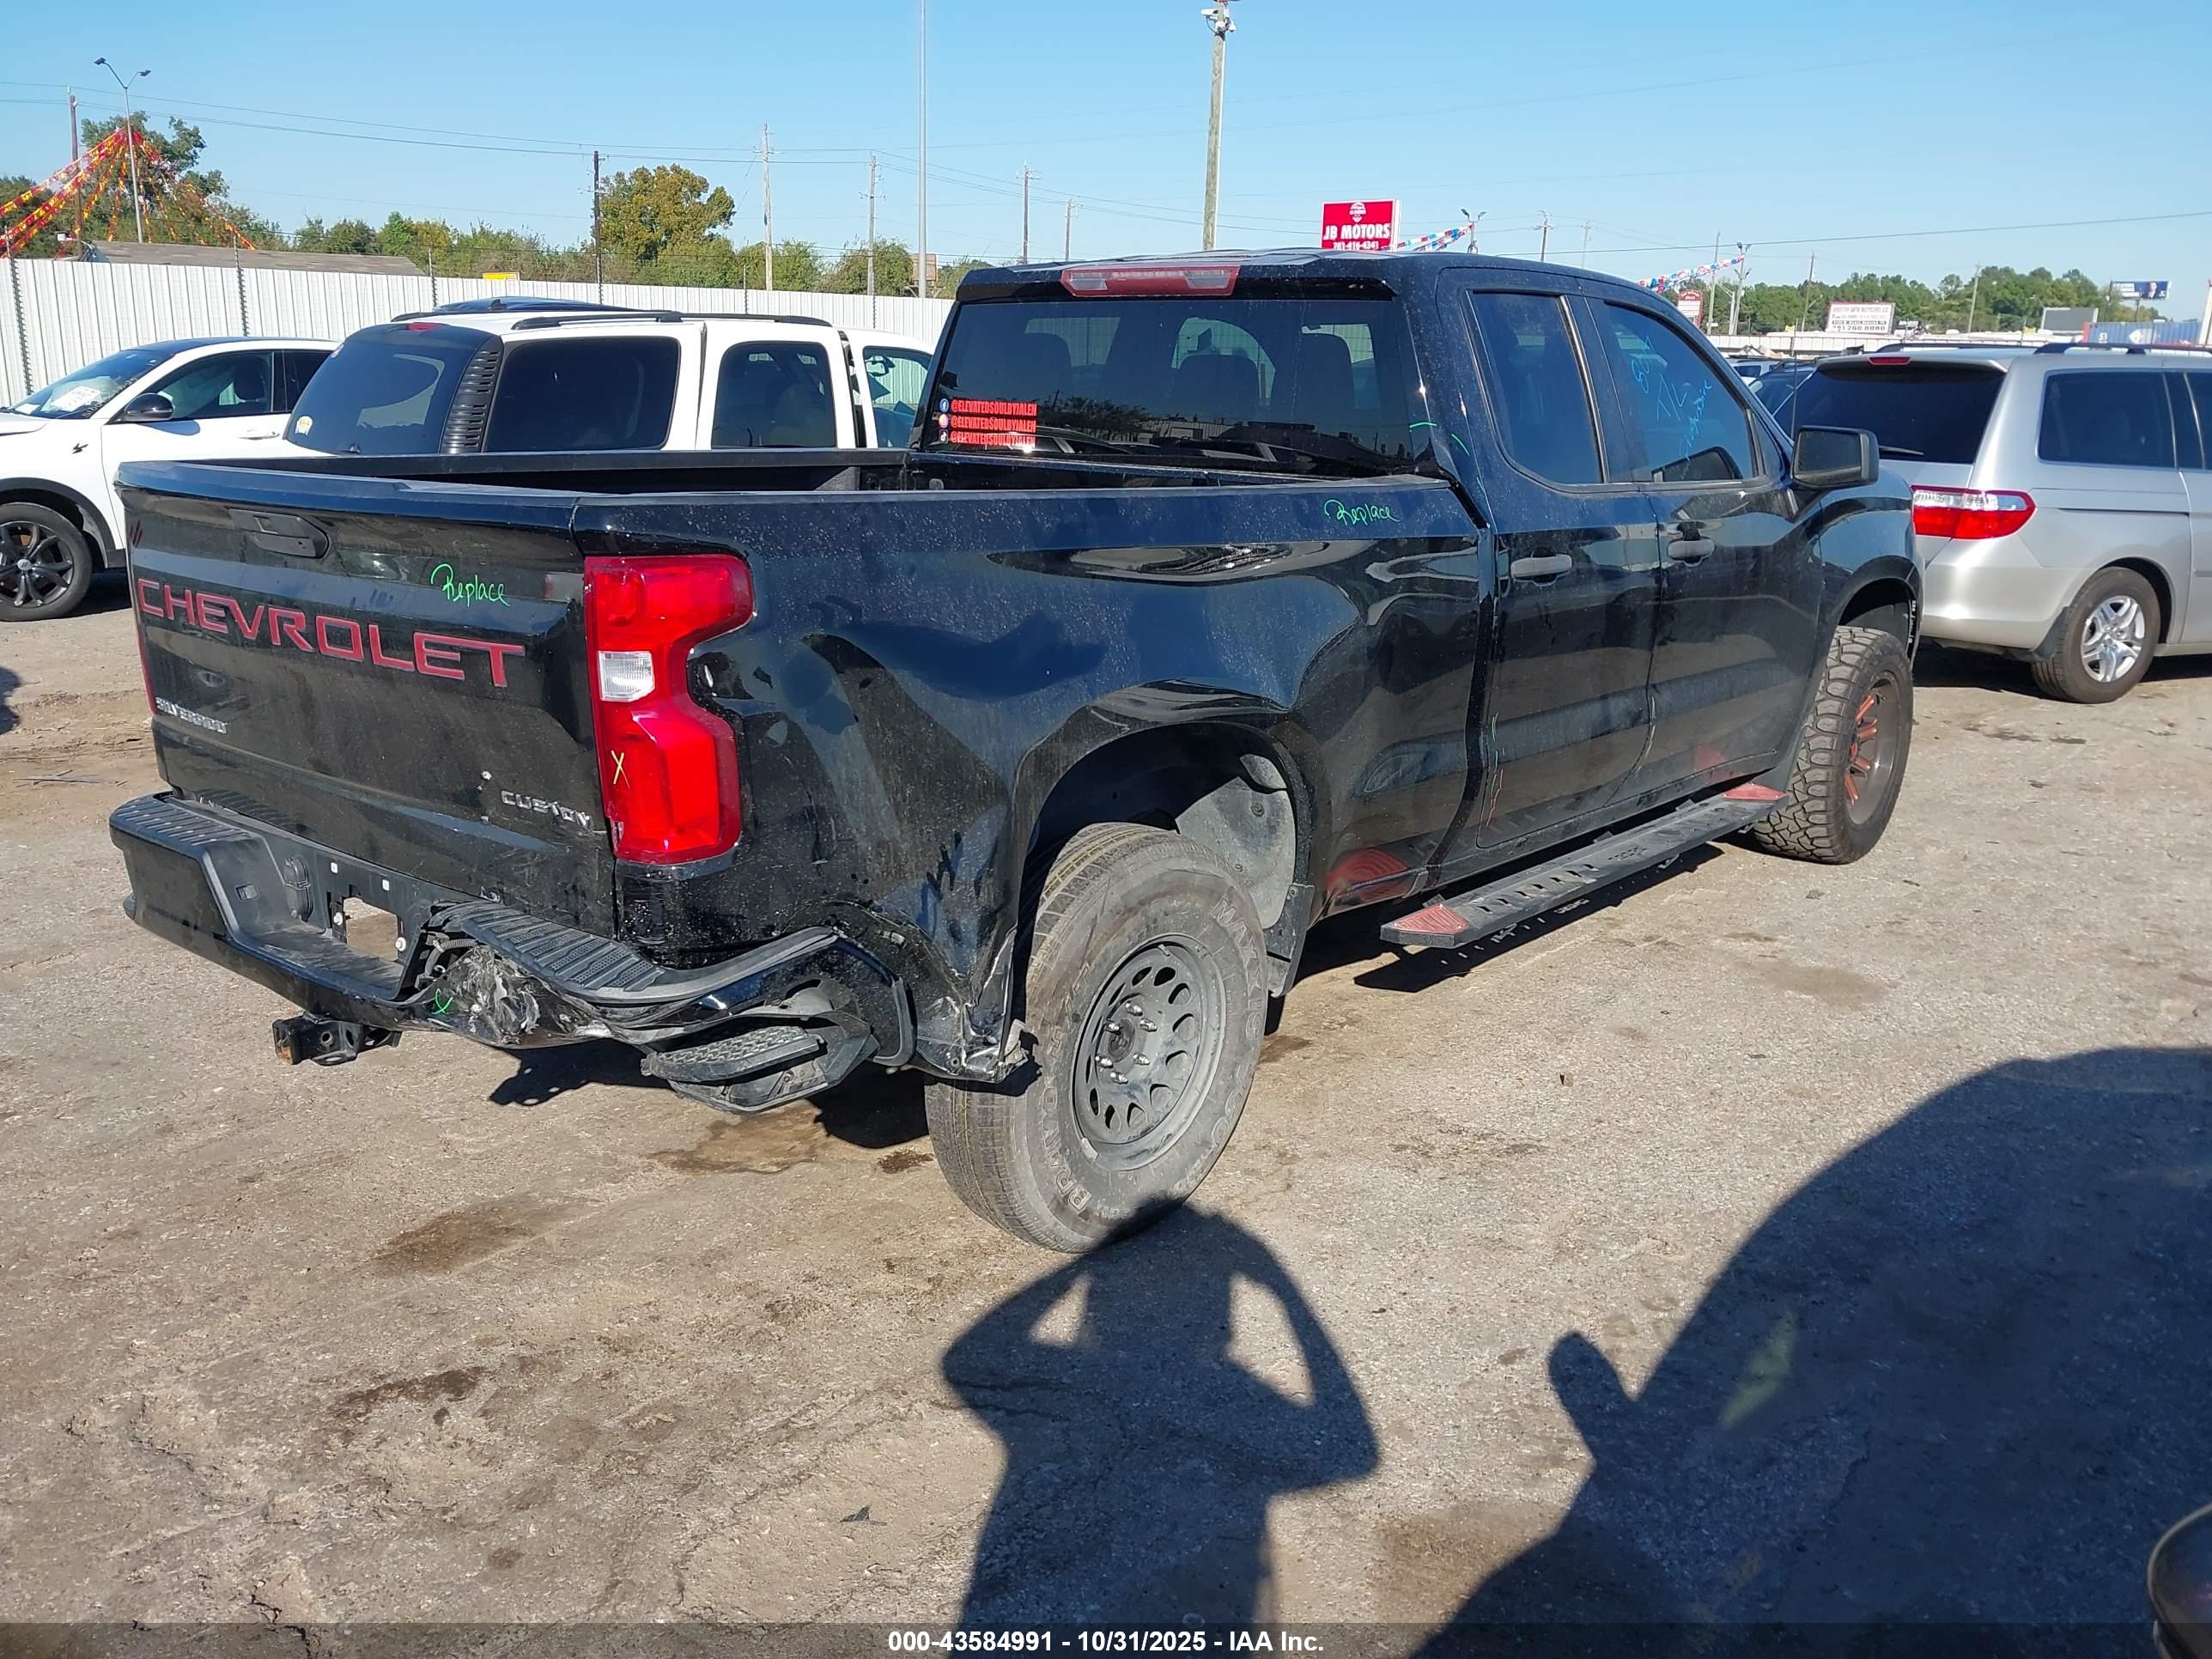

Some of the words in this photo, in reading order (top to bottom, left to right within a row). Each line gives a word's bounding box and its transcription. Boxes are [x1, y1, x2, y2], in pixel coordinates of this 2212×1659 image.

[1323, 225, 1338, 240] JB
[1340, 223, 1390, 240] MOTORS
[1323, 499, 1402, 526] Replace
[431, 563, 510, 607] Replace
[137, 578, 526, 688] CHEVROLET
[155, 696, 228, 735] SILVERADO
